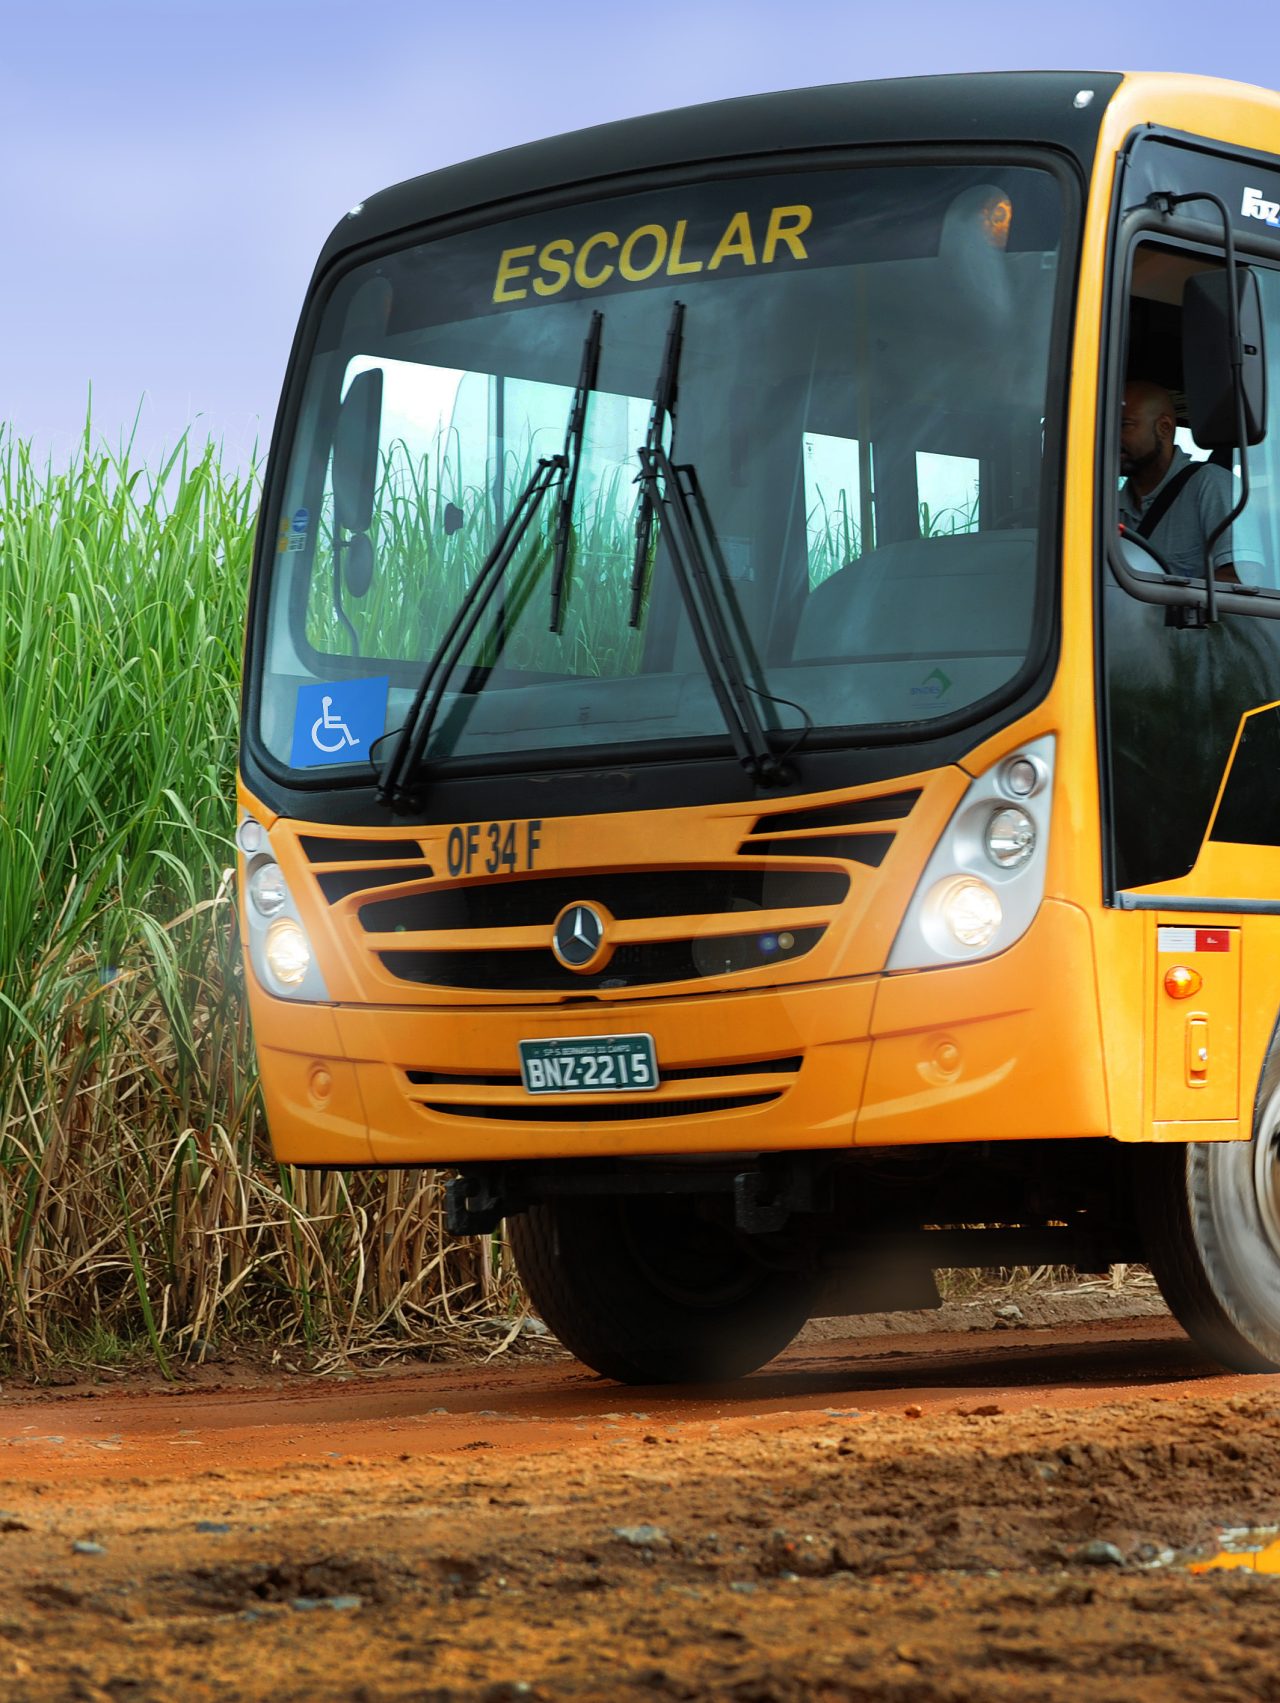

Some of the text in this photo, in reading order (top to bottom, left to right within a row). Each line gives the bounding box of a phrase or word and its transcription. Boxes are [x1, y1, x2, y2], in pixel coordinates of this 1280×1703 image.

[493, 204, 813, 303] ESCOLAR
[447, 820, 542, 877] OF 34 F
